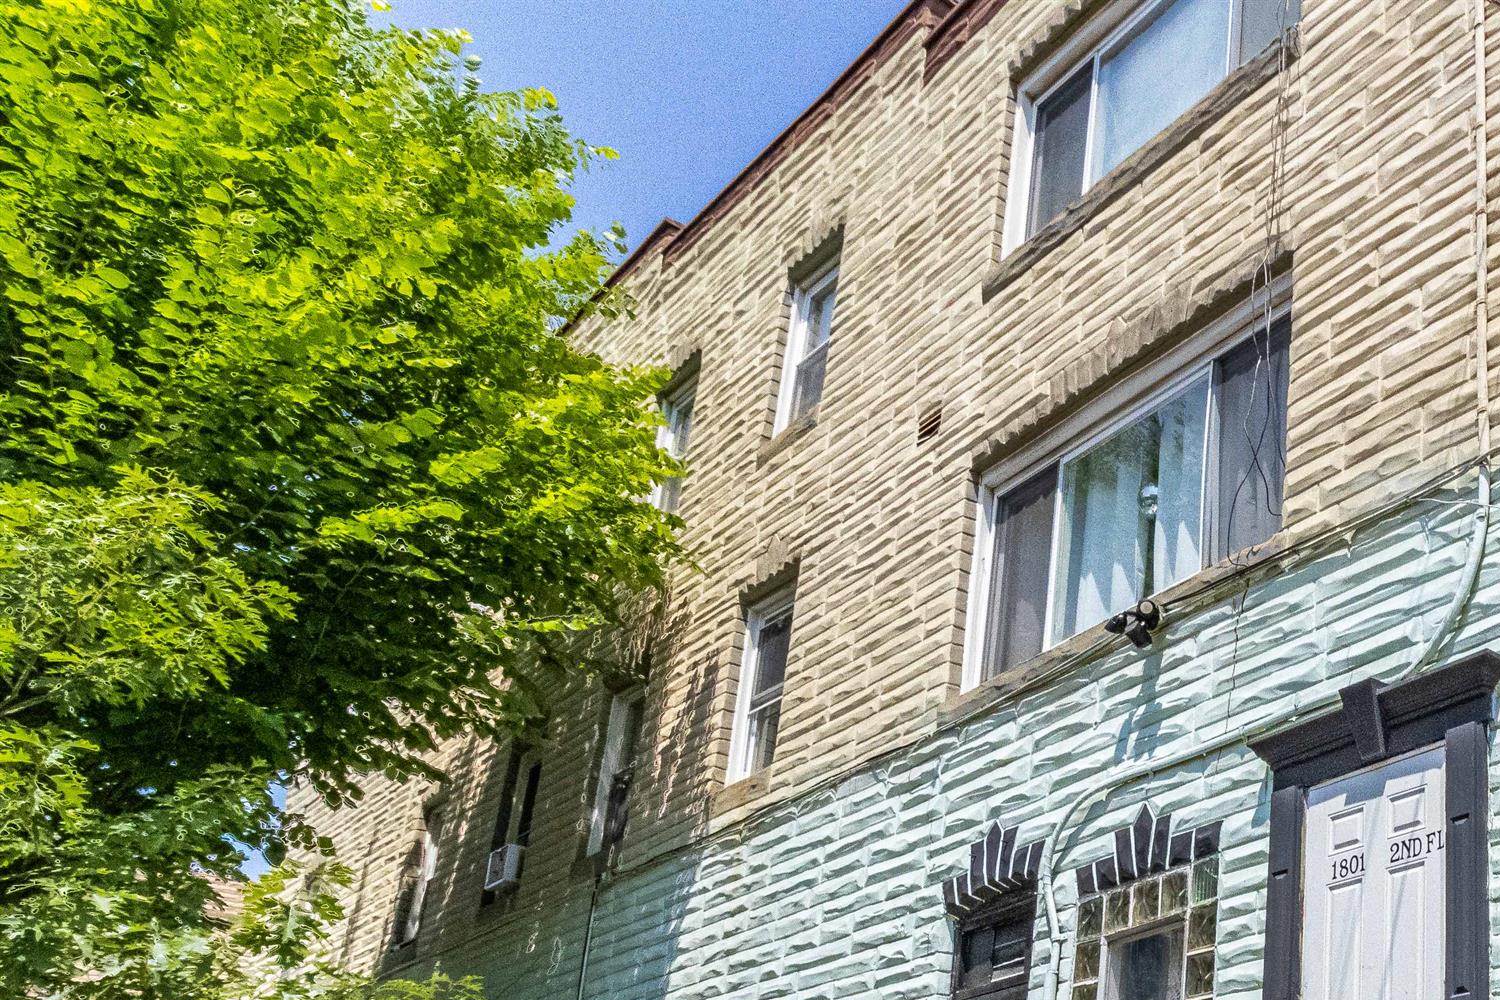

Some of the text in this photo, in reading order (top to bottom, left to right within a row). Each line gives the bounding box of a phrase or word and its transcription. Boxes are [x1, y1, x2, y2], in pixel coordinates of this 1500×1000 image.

[1390, 830, 1444, 863] 2ND FL
[1332, 852, 1365, 880] 1801
